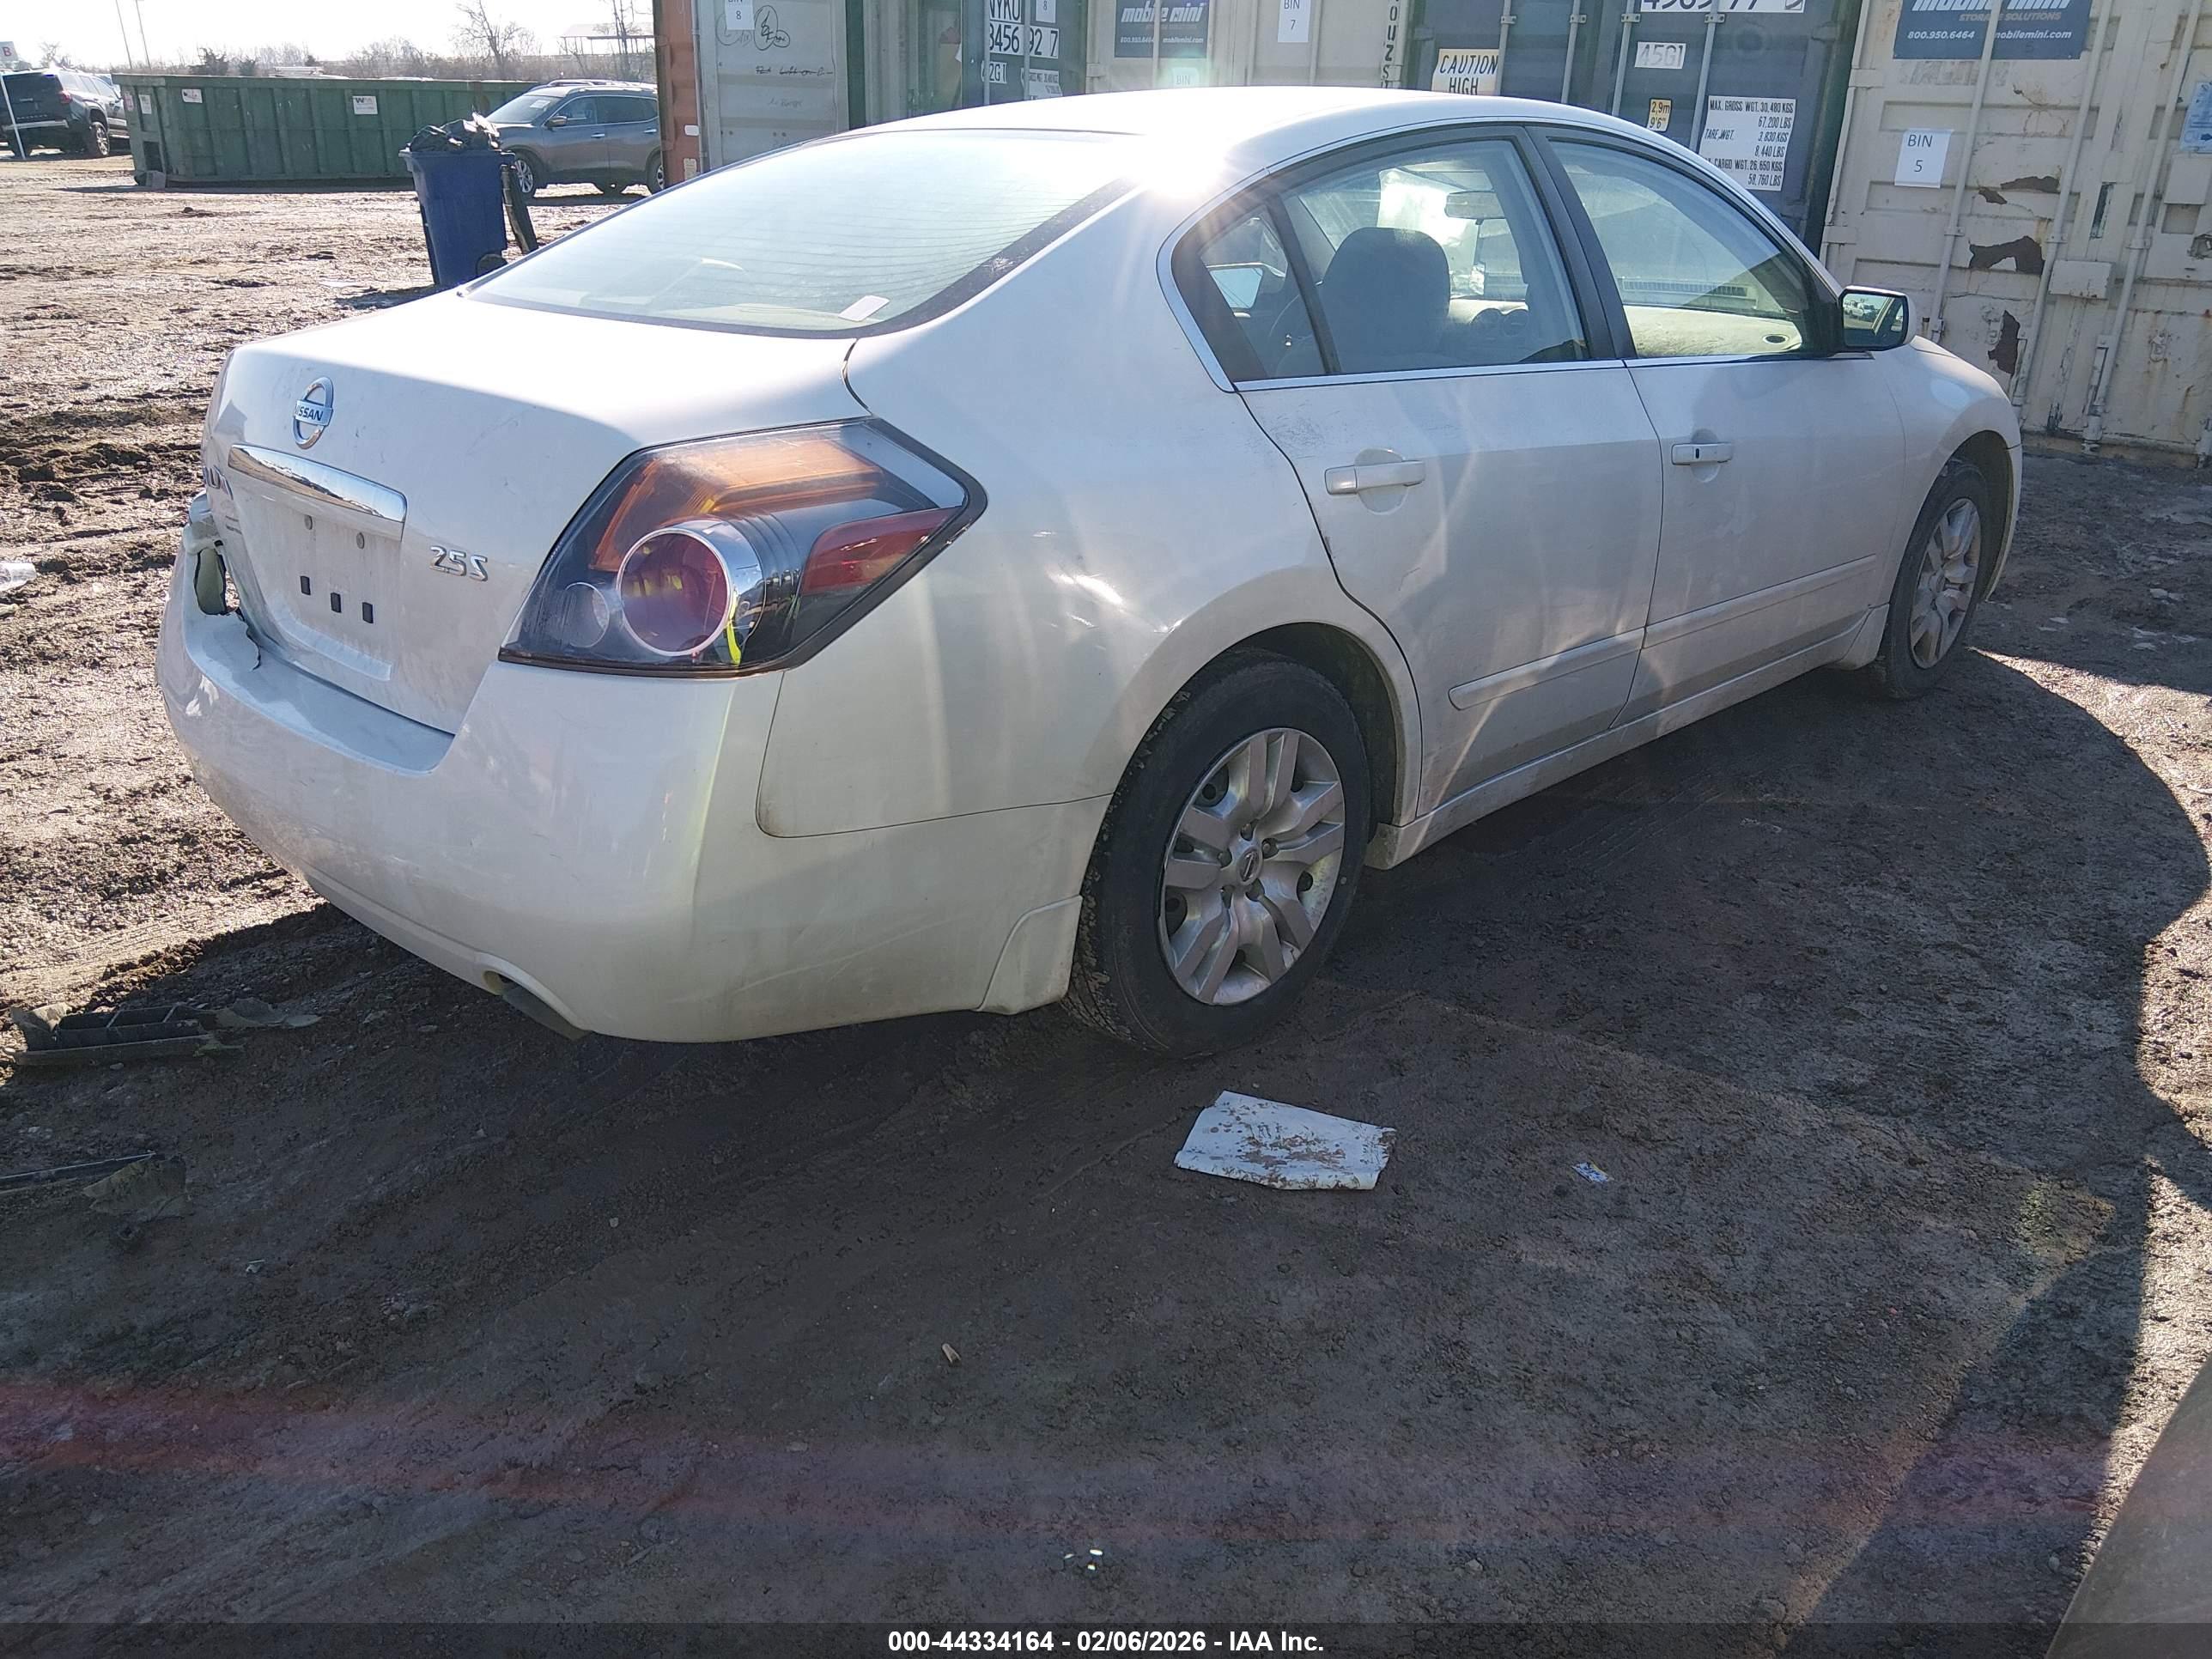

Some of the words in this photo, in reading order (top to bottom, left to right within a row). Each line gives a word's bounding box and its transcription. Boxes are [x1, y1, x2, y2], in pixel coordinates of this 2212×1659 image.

[736, 10, 742, 20] 8
[1121, 1, 1169, 22] mobie
[1169, 3, 1206, 22] mini
[1959, 13, 2004, 21] STORAE
[2004, 12, 2062, 21] SOLUTIONS
[1291, 20, 1297, 30] 7
[1907, 30, 1975, 40] 800.950.6464
[3, 46, 11, 56] B
[1439, 54, 1498, 75] CAUTION
[1449, 76, 1479, 95] HIGH
[1725, 100, 1743, 111] GROSS
[1782, 103, 1794, 112] KGS
[1779, 117, 1792, 129] LBS
[1777, 132, 1789, 143] KGS
[1908, 134, 1933, 147] BIN
[1773, 146, 1785, 157] LBS
[1771, 161, 1783, 172] KGS
[1914, 159, 1923, 172] 5
[1769, 174, 1782, 186] LBS
